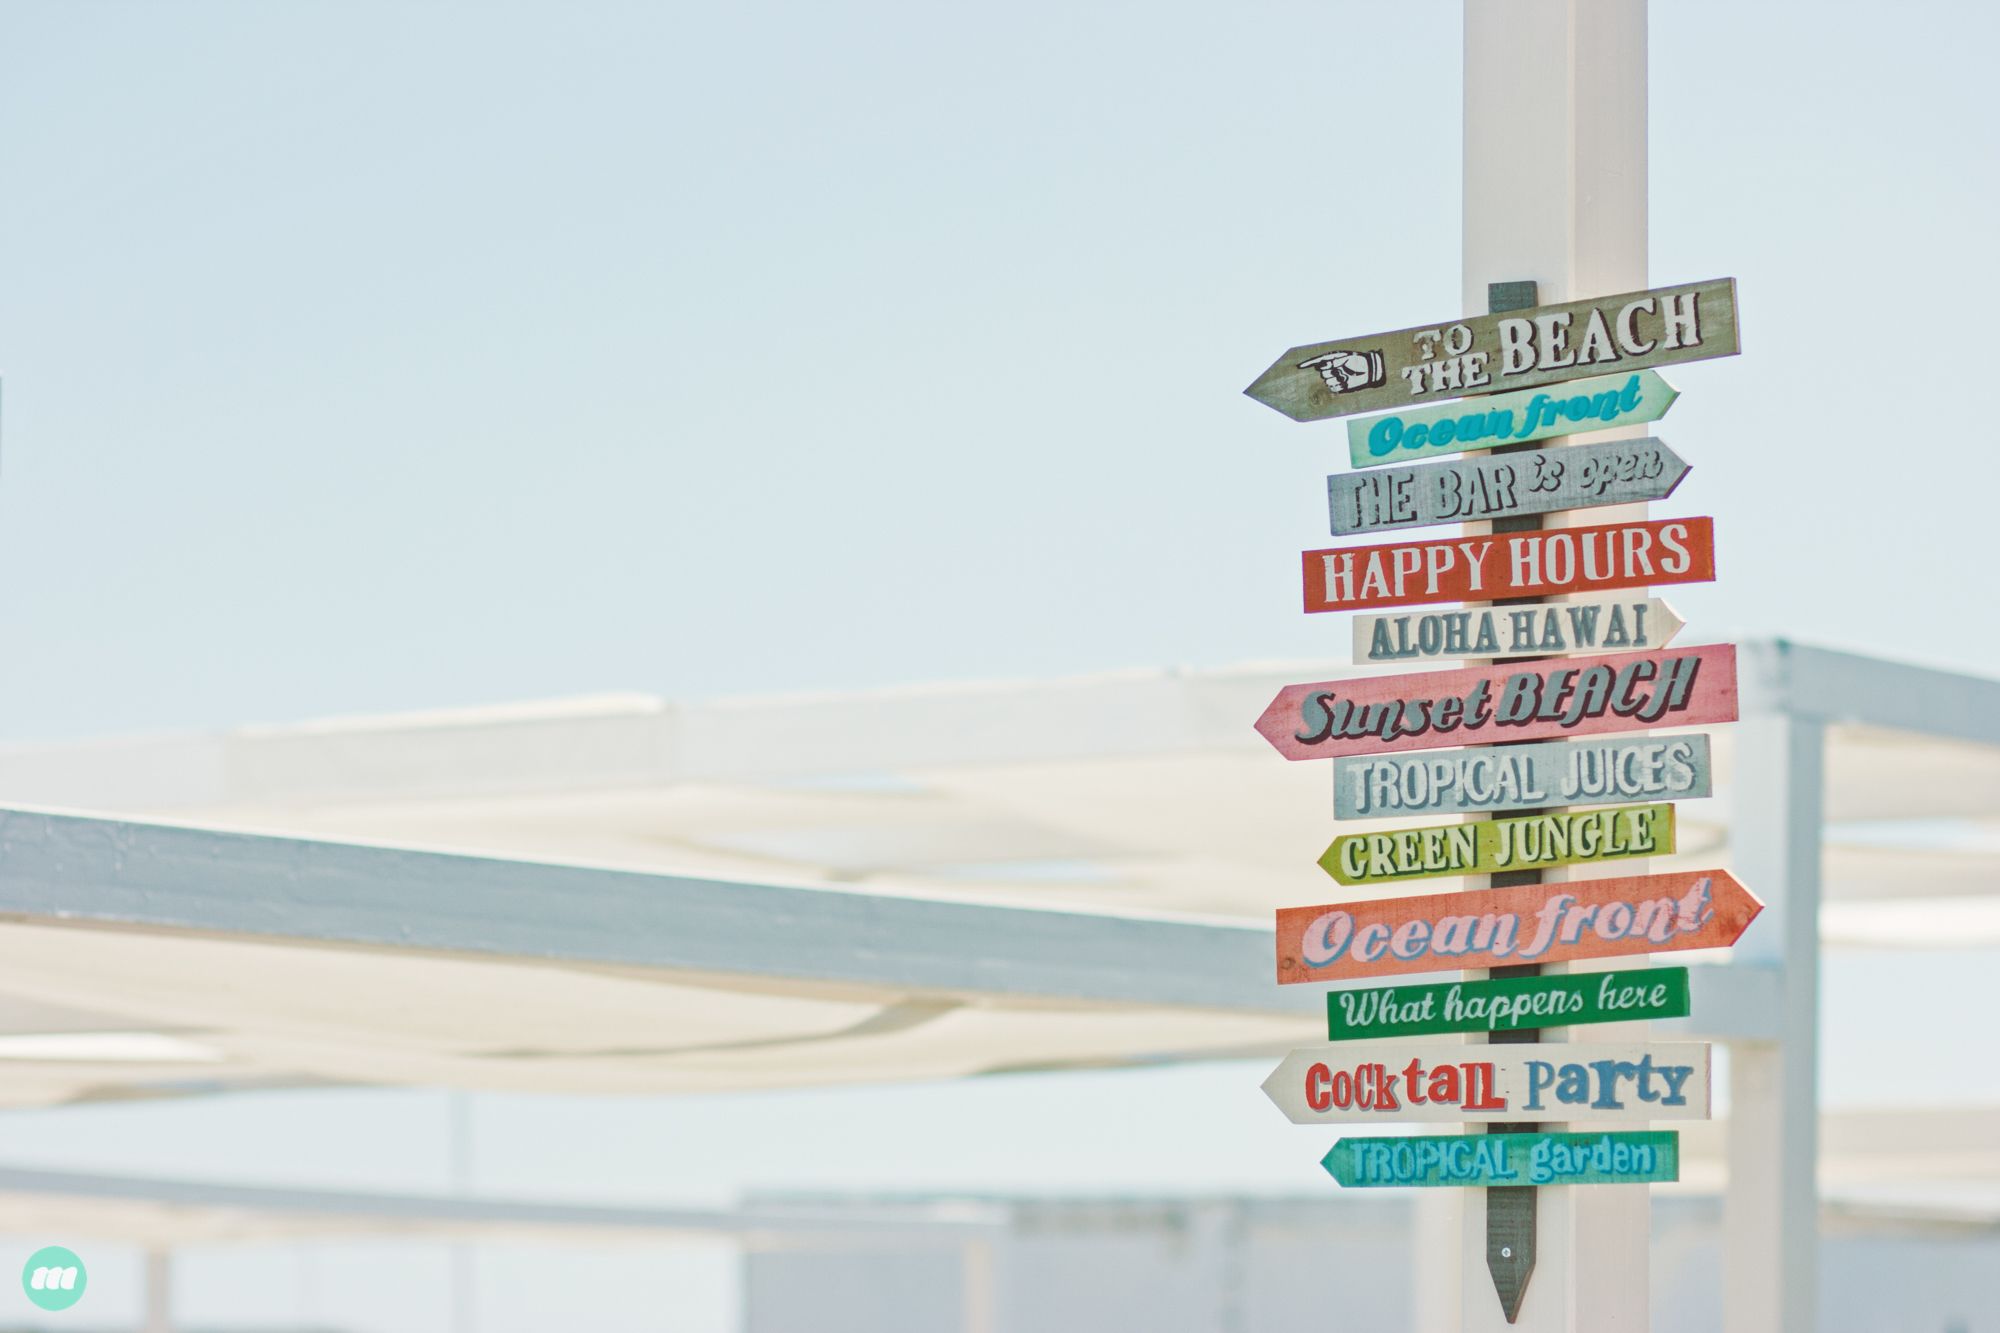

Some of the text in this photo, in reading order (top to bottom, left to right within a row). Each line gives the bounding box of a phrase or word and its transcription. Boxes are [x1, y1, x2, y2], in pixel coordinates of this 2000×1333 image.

[1413, 323, 1475, 361] TO
[1498, 292, 1704, 377] BEACH
[1401, 352, 1491, 394] THE
[1368, 374, 1644, 457] Ocean front
[1350, 450, 1665, 528] THE BAR is open
[1322, 523, 1692, 602] HAPPY HOURS
[1368, 603, 1648, 660] ALOHA HAWAI
[1295, 655, 1703, 745] Sunset BEACH
[1345, 741, 1698, 814] TROPICAL JUICES
[1340, 808, 1657, 880] GREEN JUNGLE
[1301, 877, 1716, 970] Ocean front
[1340, 973, 1668, 1030] What happens here
[1350, 1134, 1659, 1183] TROPICAL garden
